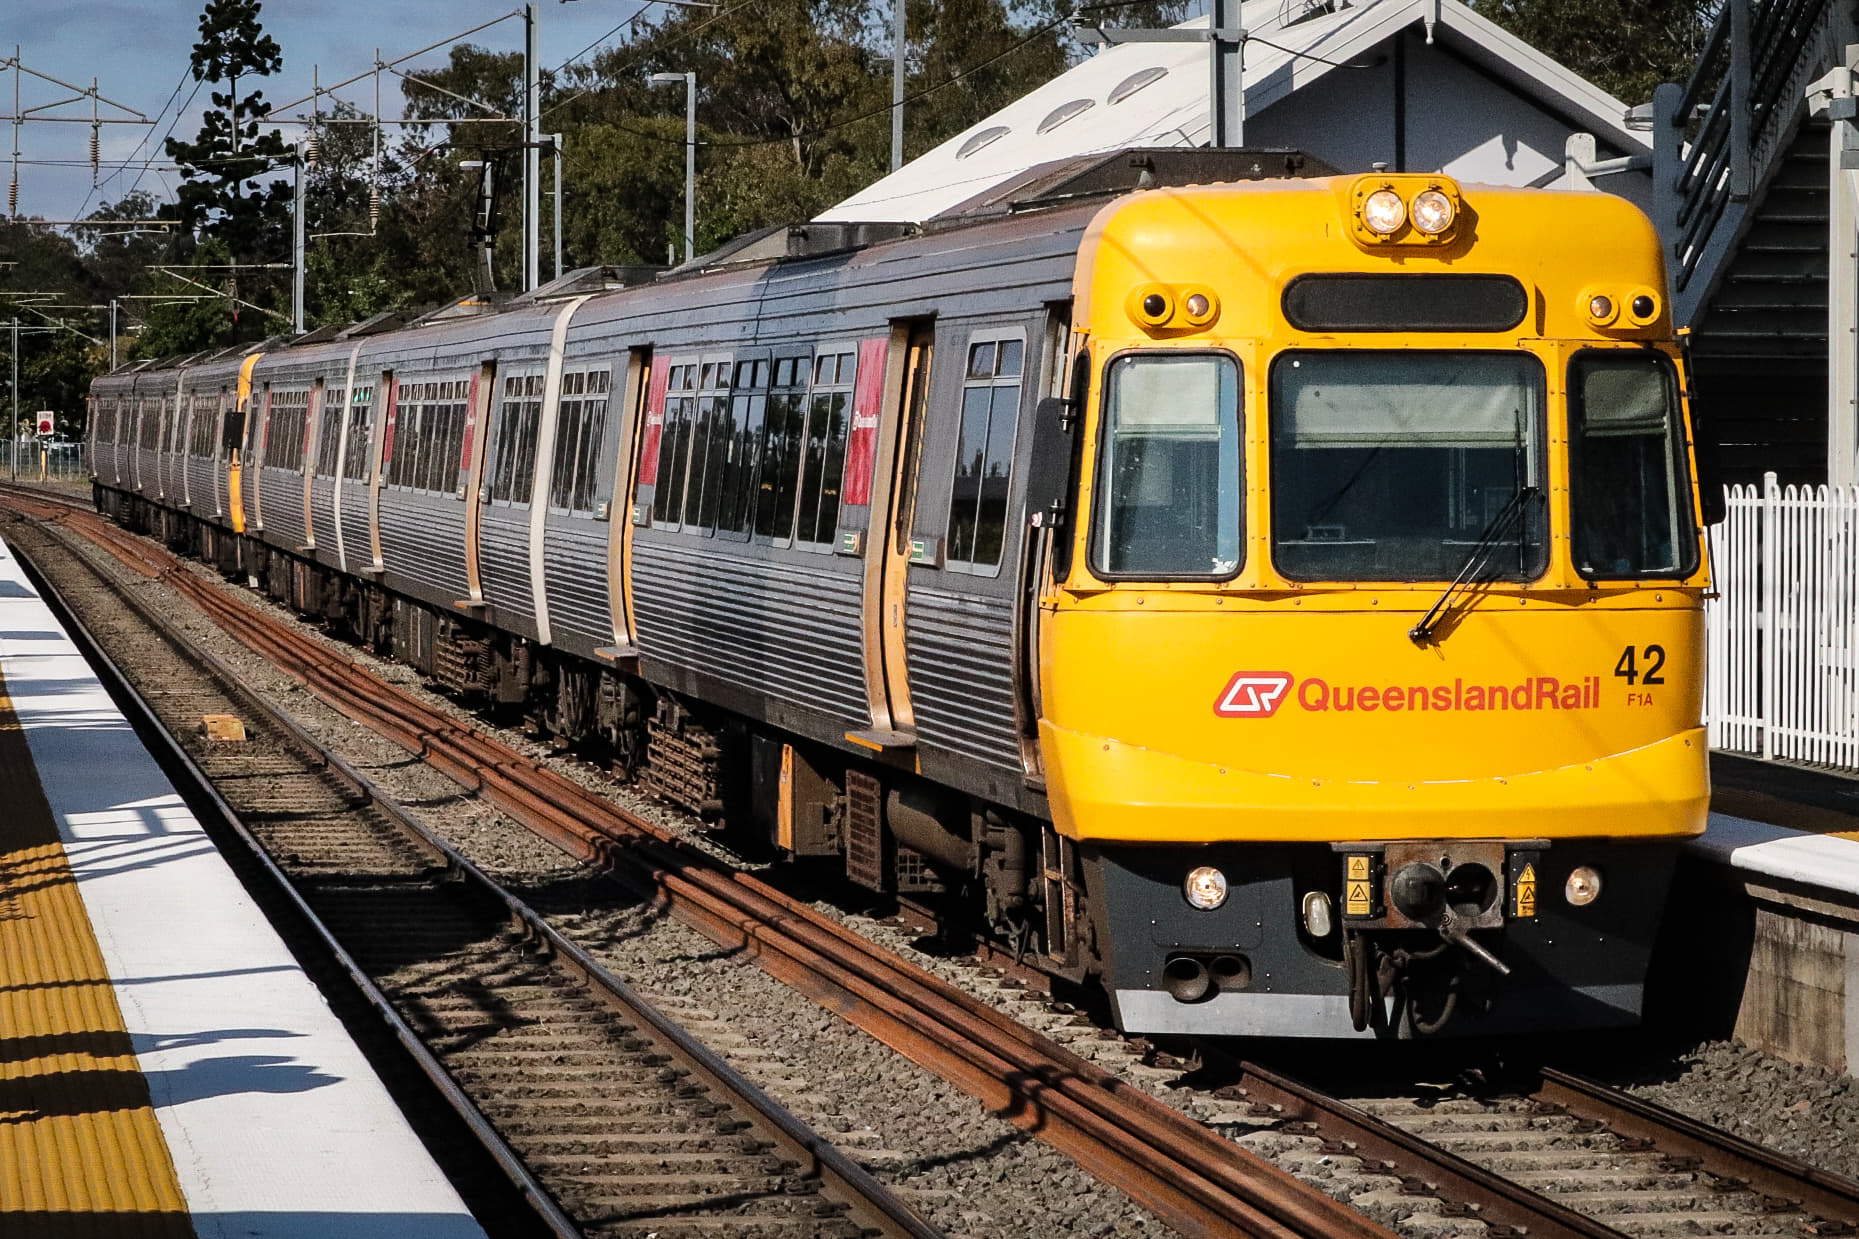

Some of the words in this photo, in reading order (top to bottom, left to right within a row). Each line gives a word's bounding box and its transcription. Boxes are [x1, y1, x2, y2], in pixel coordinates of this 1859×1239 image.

[1614, 644, 1666, 685] 42
[1297, 676, 1600, 712] QueenslandRail
[1627, 692, 1654, 706] F1A
